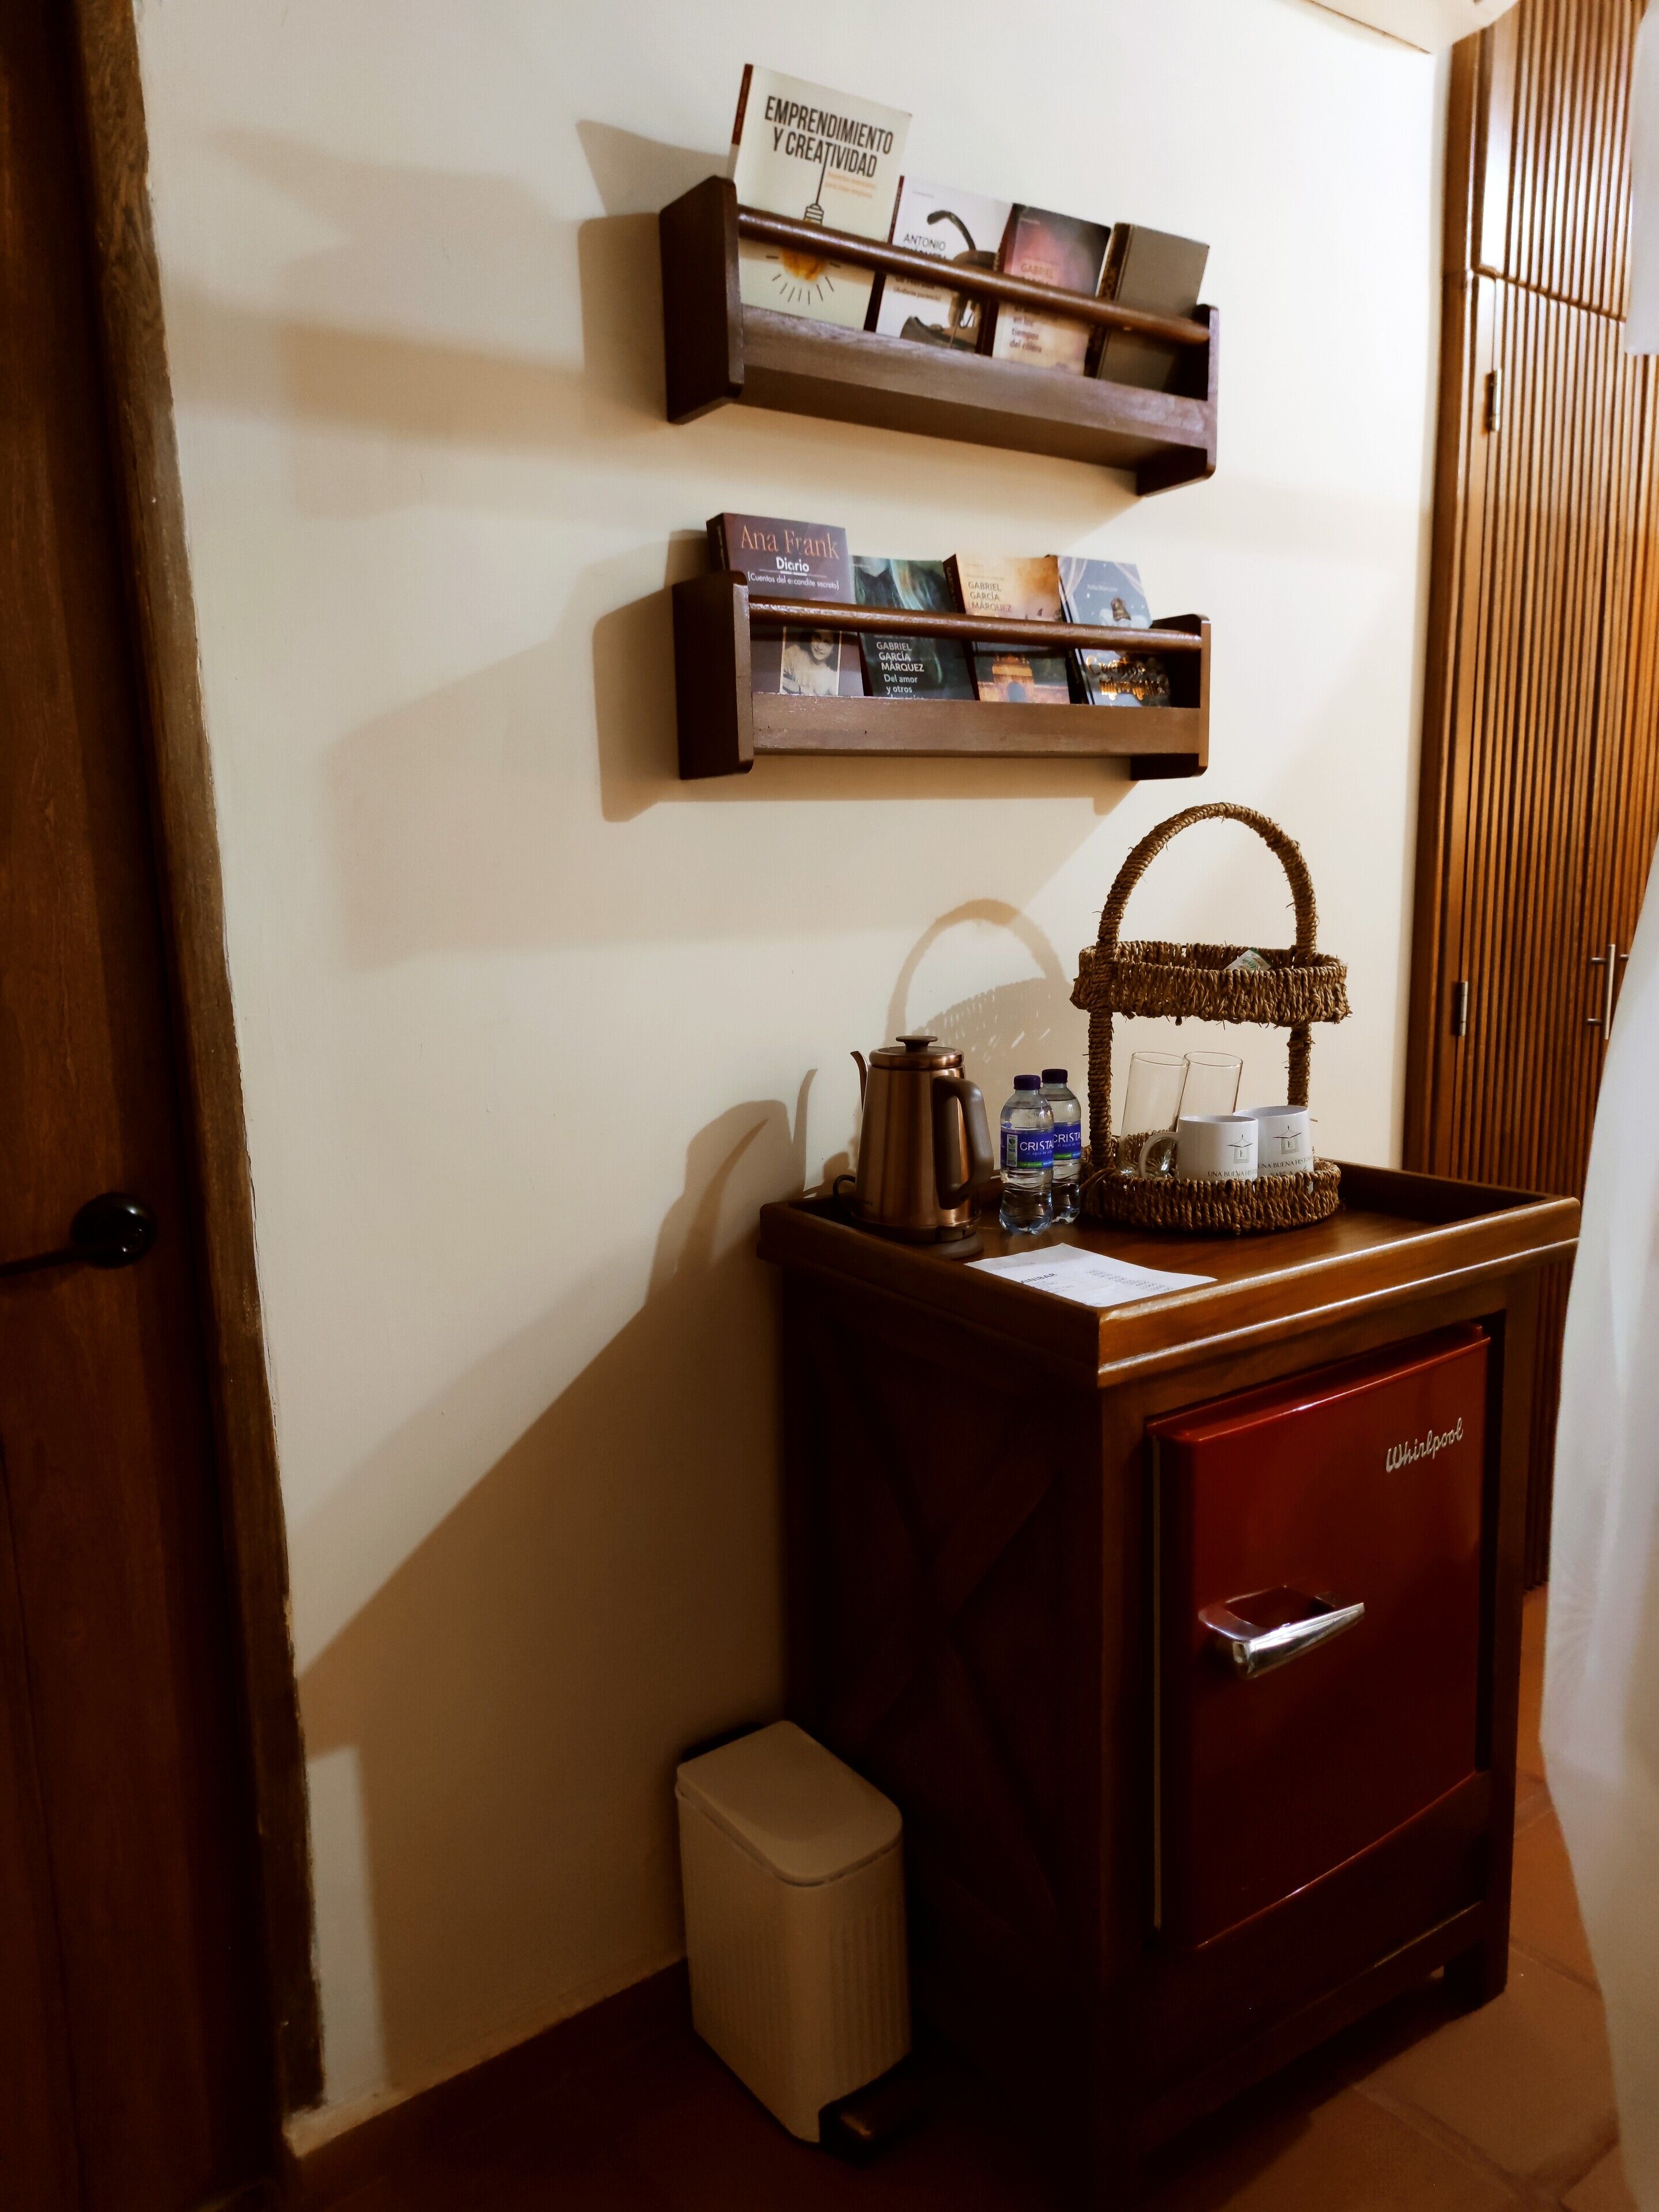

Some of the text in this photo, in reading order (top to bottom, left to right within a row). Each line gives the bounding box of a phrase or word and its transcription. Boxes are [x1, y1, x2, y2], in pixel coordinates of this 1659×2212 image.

[764, 96, 893, 154] EMPRENDIMIENTO
[774, 127, 877, 178] Y CREATIVIDAD
[904, 233, 946, 251] ANTONIO
[741, 525, 779, 552] Ana
[785, 529, 839, 559] Frank
[776, 556, 809, 572] Diario
[747, 571, 775, 583] (Cuentos
[777, 576, 786, 584] del
[968, 581, 1001, 592] GABRIEL
[970, 592, 1000, 601] GARCÍA
[972, 601, 1012, 612] MÁRQUEZ
[876, 641, 912, 651] GABRIEL
[878, 651, 911, 661] GARCÍA
[881, 661, 925, 672] MÁRQUEZ
[884, 674, 897, 683] Del
[886, 686, 891, 695] y
[1053, 1131, 1081, 1143] CRISTA
[1273, 1160, 1294, 1169] BUENA
[1386, 1417, 1464, 1474] Whirlpool
